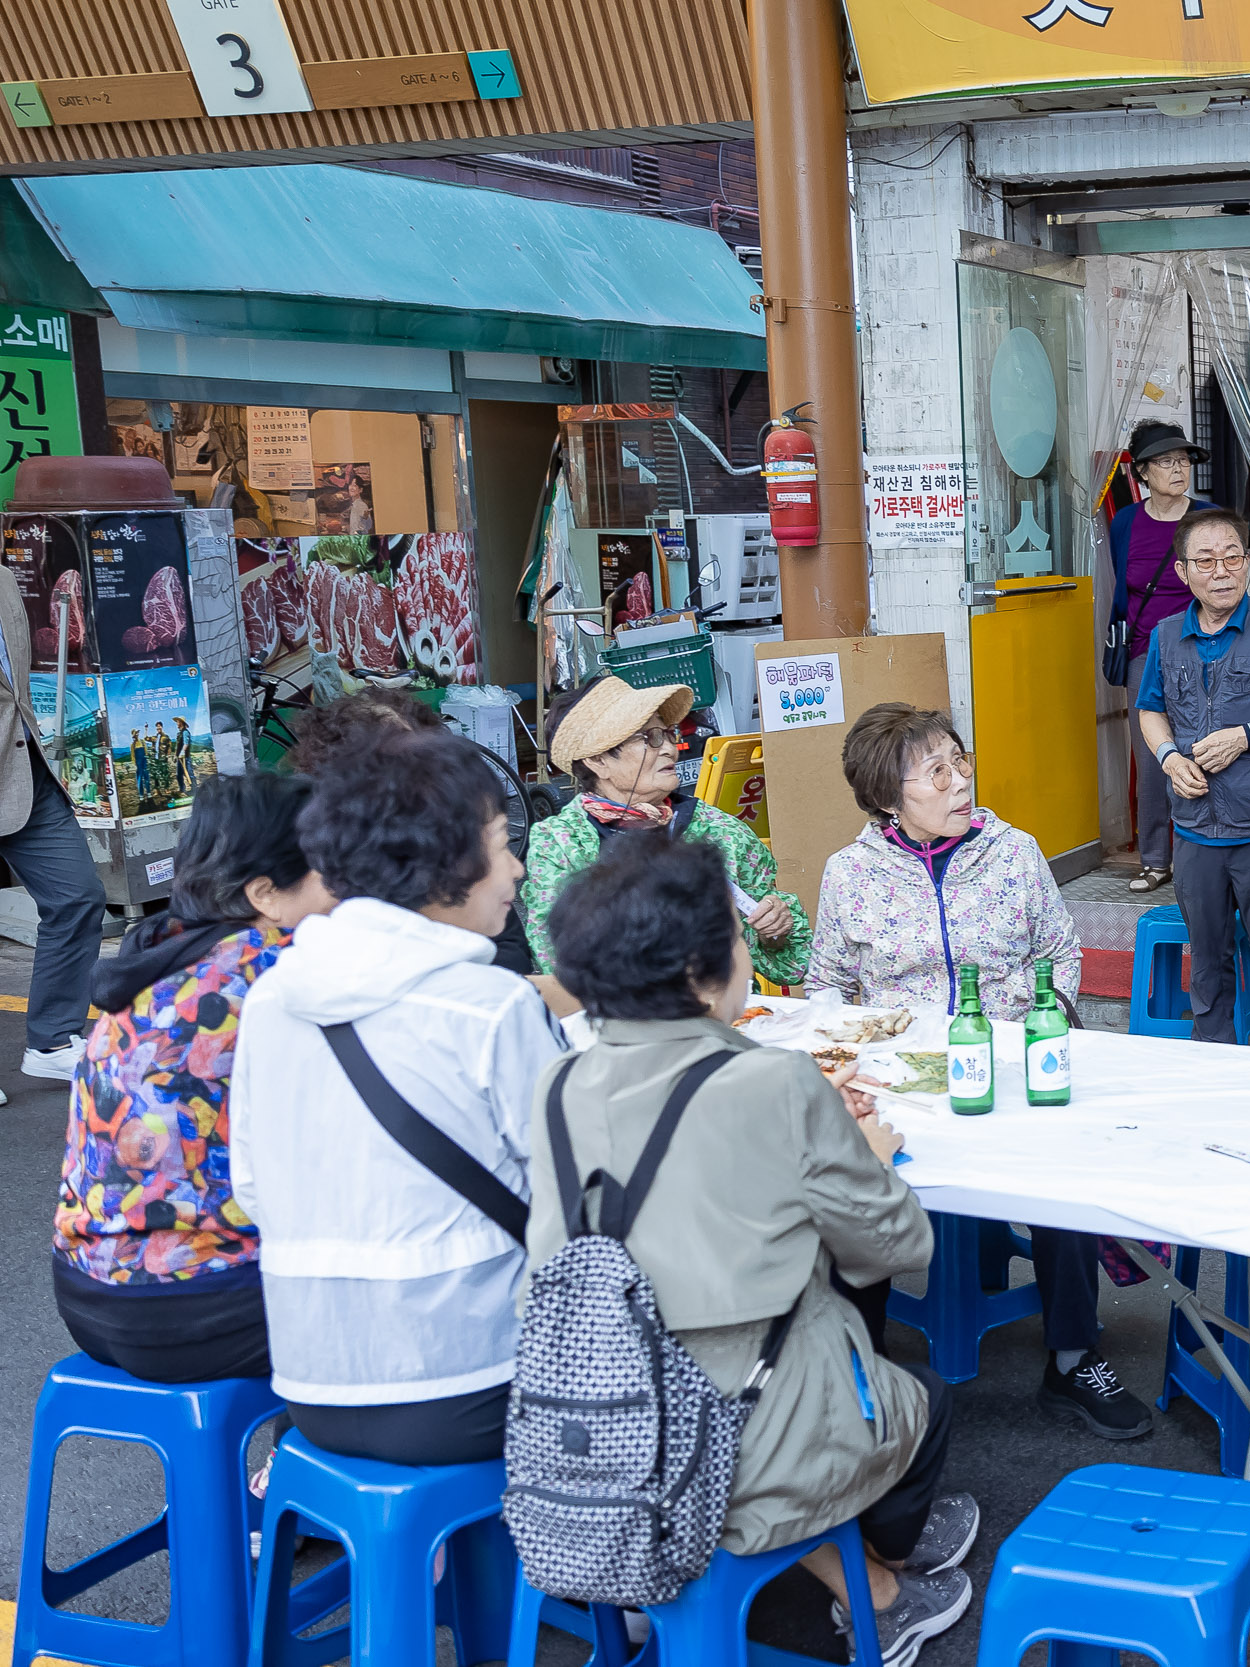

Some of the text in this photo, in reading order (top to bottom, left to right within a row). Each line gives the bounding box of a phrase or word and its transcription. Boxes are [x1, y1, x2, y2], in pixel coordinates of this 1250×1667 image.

[215, 32, 264, 98] 3
[400, 73, 428, 85] GATE
[58, 96, 84, 107] GATE
[0, 314, 69, 352] 소매
[922, 463, 947, 471] 가로주택
[873, 474, 978, 492] 재산권 침해하는
[874, 493, 979, 519] 가로주택 결사반
[766, 662, 834, 686] 해물파전
